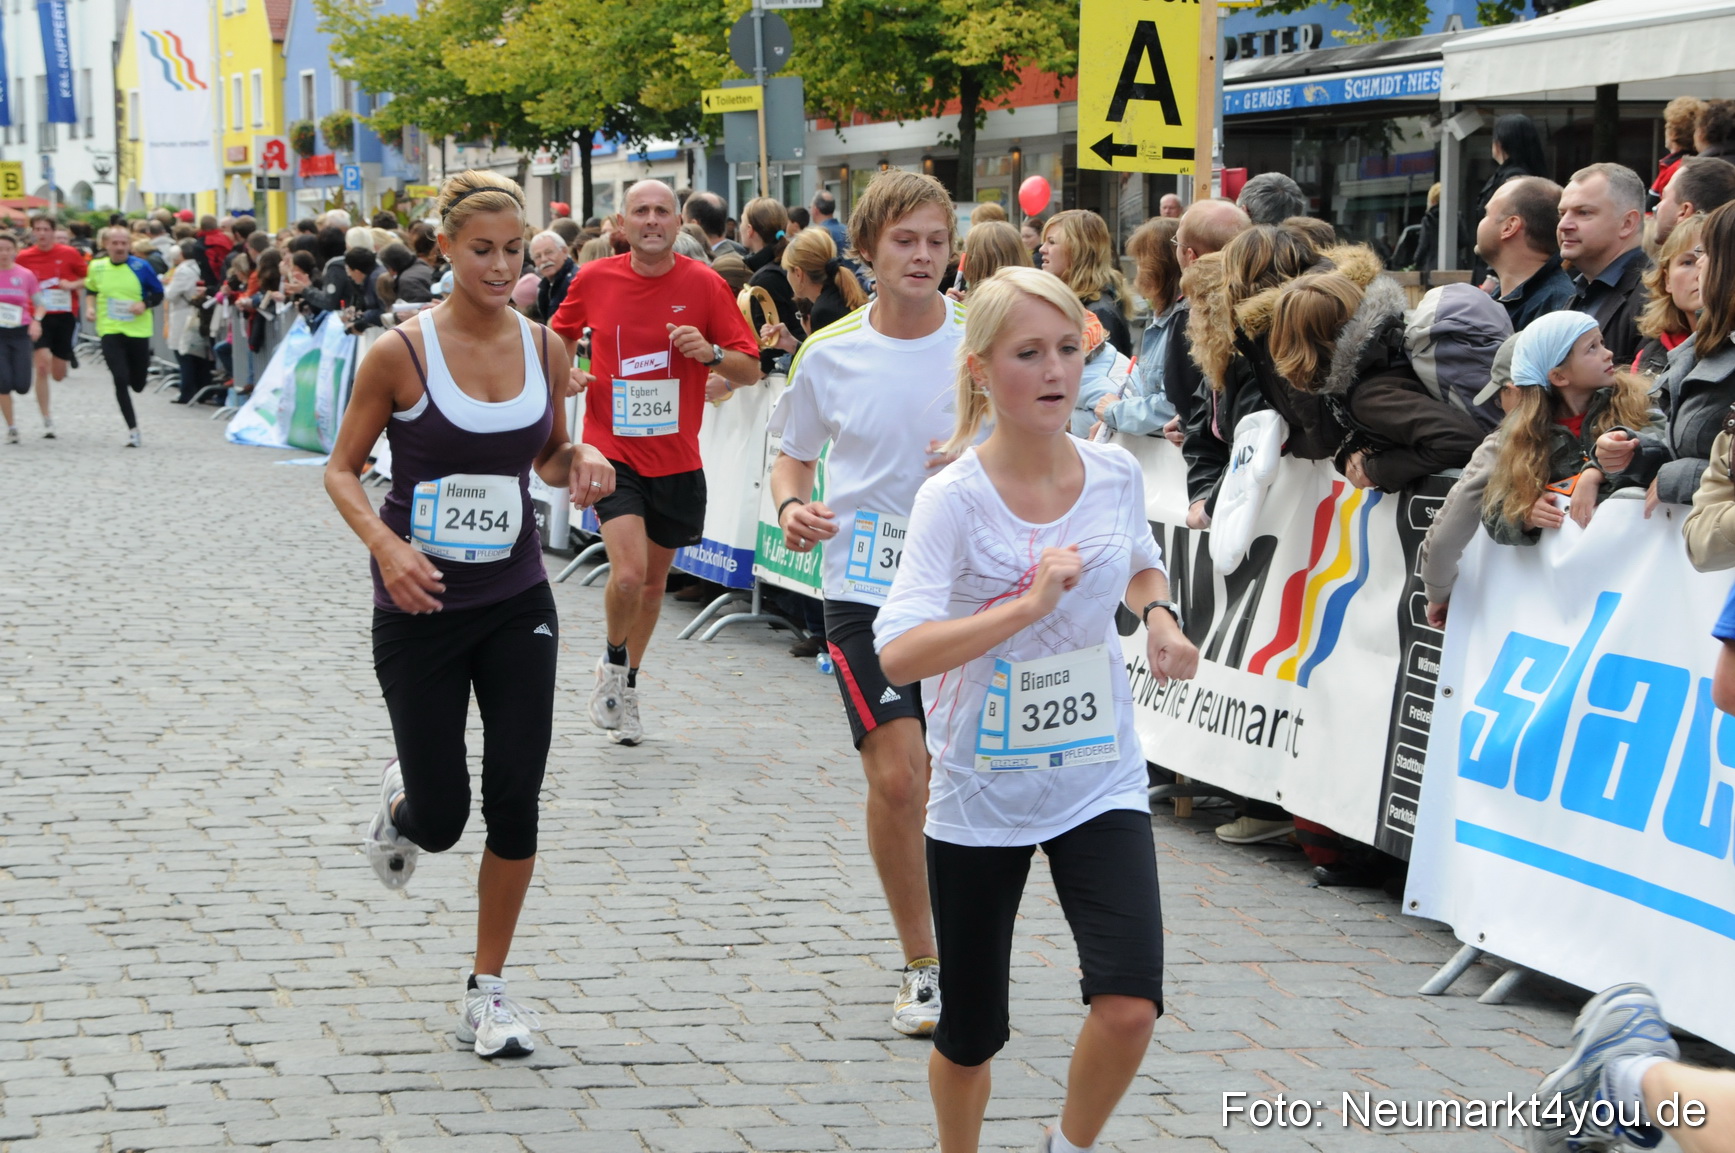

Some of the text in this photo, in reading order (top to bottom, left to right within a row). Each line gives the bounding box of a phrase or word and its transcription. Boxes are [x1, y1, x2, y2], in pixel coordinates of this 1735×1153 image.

[1224, 24, 1322, 61] ETER
[1105, 20, 1182, 126] A
[715, 95, 754, 106] Toiletten
[1243, 88, 1291, 109] GEMÜSE
[5, 172, 20, 191] B
[346, 168, 357, 189] P
[634, 358, 656, 370] DEHN
[630, 386, 659, 398] Egbert
[632, 400, 672, 417] 2364
[446, 482, 486, 499] Hanna
[420, 504, 427, 516] B
[444, 507, 510, 532] 2454
[882, 521, 908, 540] Dom
[857, 541, 865, 553] B
[1021, 669, 1070, 692] Bianca
[988, 701, 997, 717] B
[1021, 691, 1097, 732] 3283
[1064, 743, 1117, 760] PFLEIDERER
